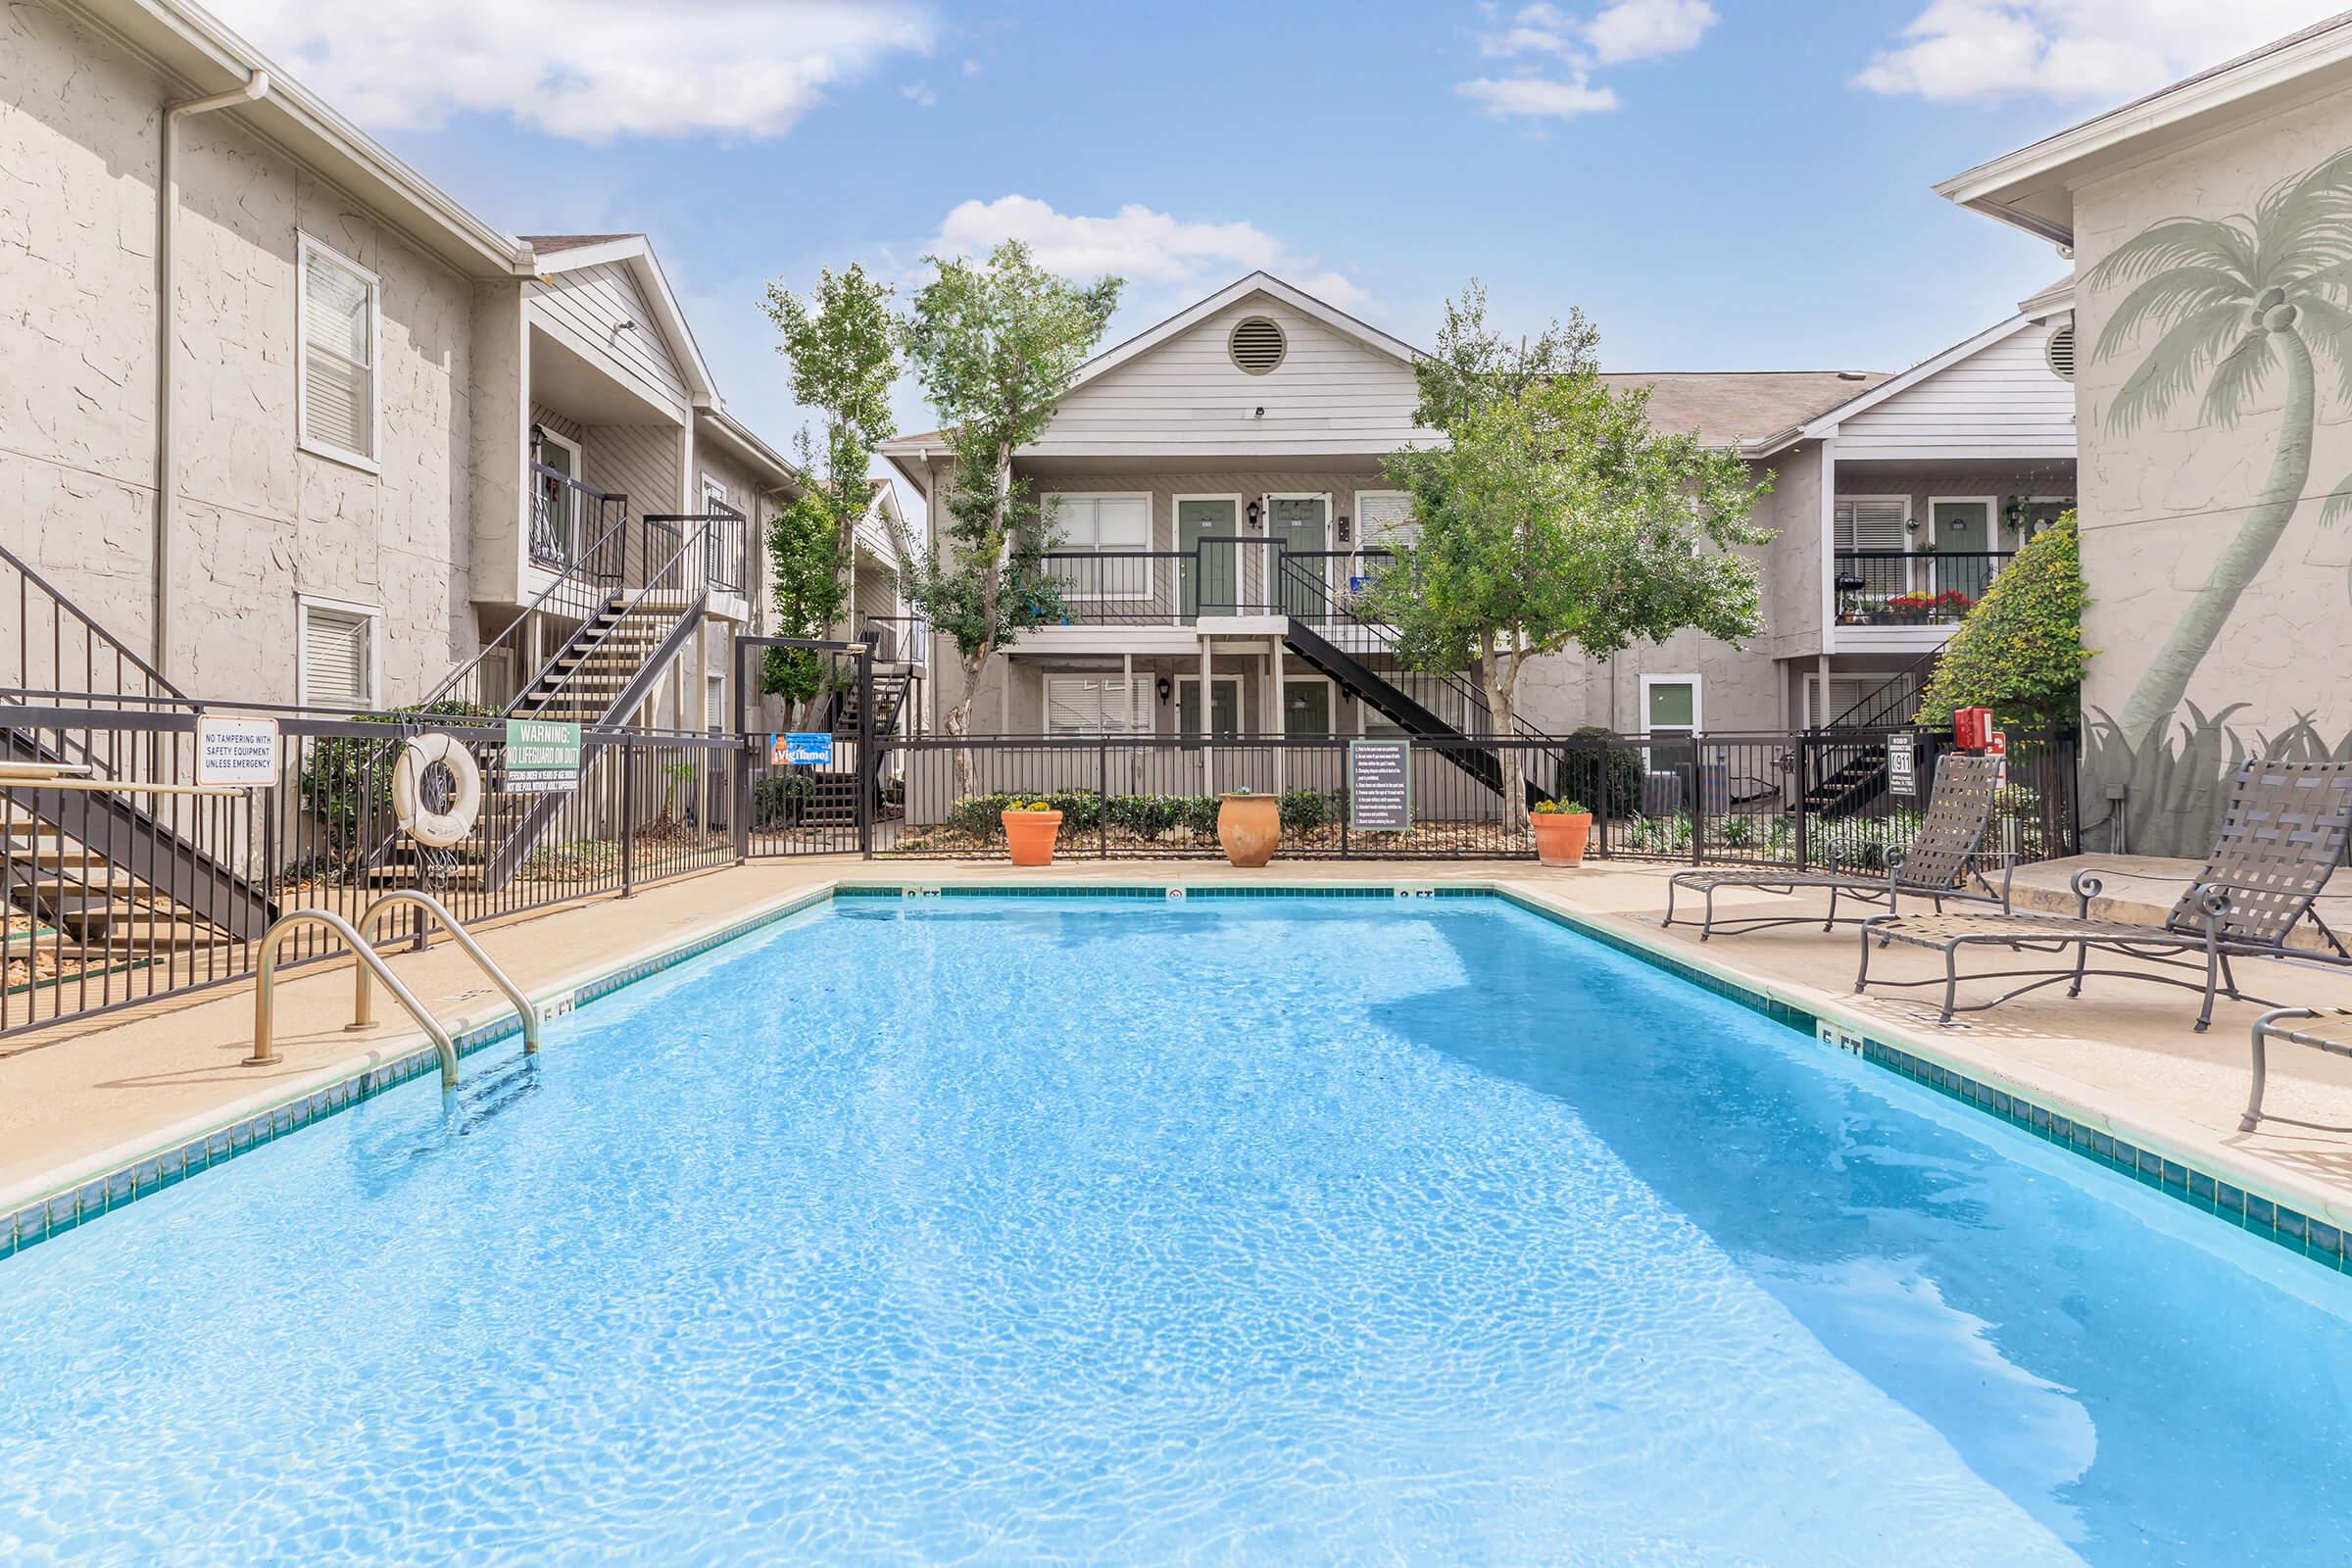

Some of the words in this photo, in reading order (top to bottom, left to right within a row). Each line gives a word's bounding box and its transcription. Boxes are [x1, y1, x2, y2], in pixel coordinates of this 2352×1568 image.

[206, 734, 216, 743] NO
[218, 734, 255, 744] TAMPERING
[256, 735, 271, 744] WITH
[520, 724, 570, 743] WARNING:
[206, 747, 232, 756] SAFETY
[234, 747, 270, 756] EQUIPMENT
[507, 746, 517, 764] NO
[518, 746, 554, 764] LIFEGUARD
[206, 760, 231, 768] UNLESS
[232, 760, 271, 768] EMERGENCY
[1896, 755, 1910, 770] 911
[1840, 1035, 1861, 1055] FT
